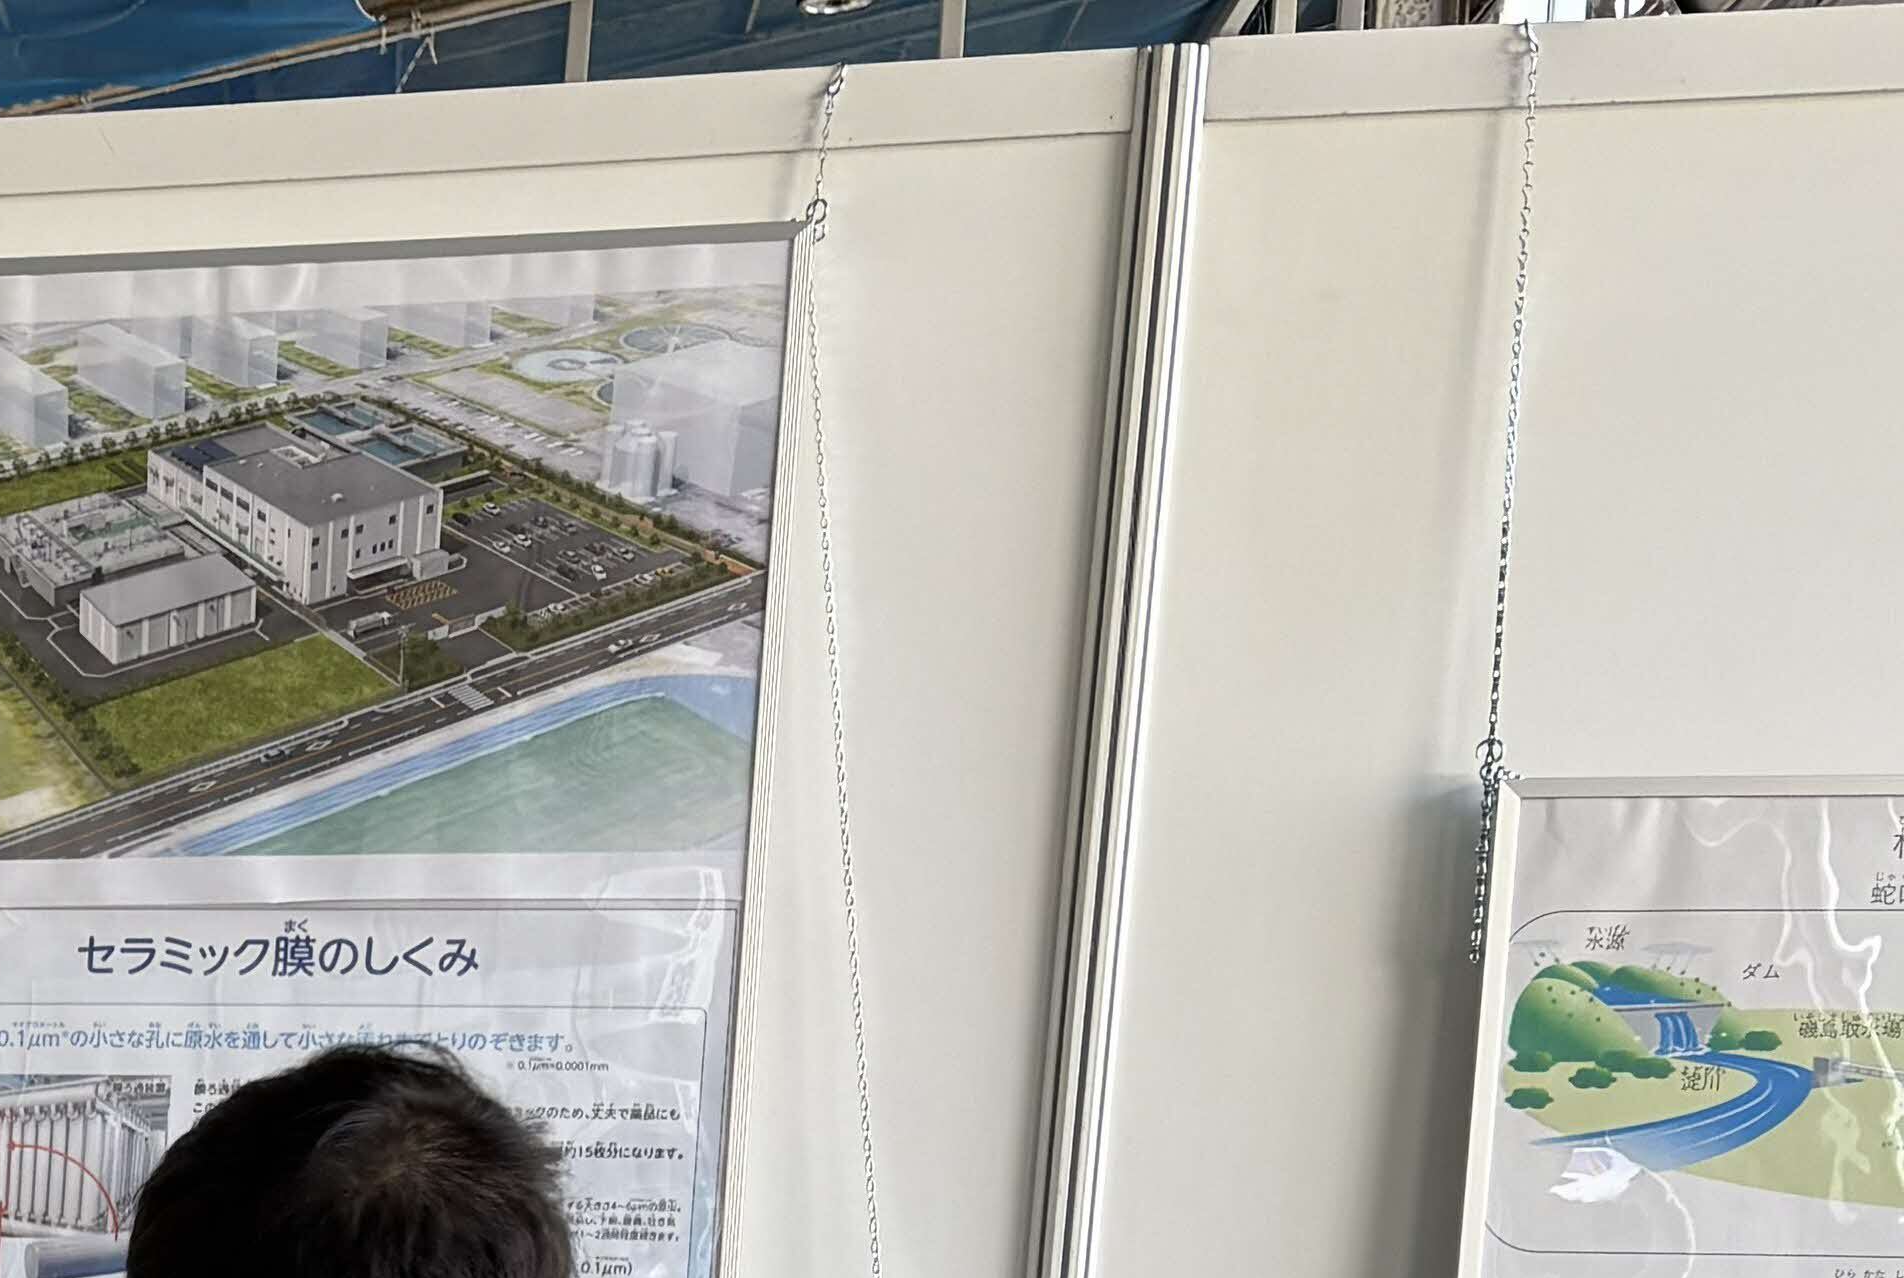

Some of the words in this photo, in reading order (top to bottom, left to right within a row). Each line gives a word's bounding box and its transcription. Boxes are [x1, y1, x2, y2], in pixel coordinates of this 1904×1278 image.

[1870, 883, 1904, 905] 蛇
[283, 919, 310, 933] まく
[1585, 934, 1626, 950] 水源
[77, 935, 480, 978] セラミック膜のしくみ
[1742, 963, 1780, 981] ダム
